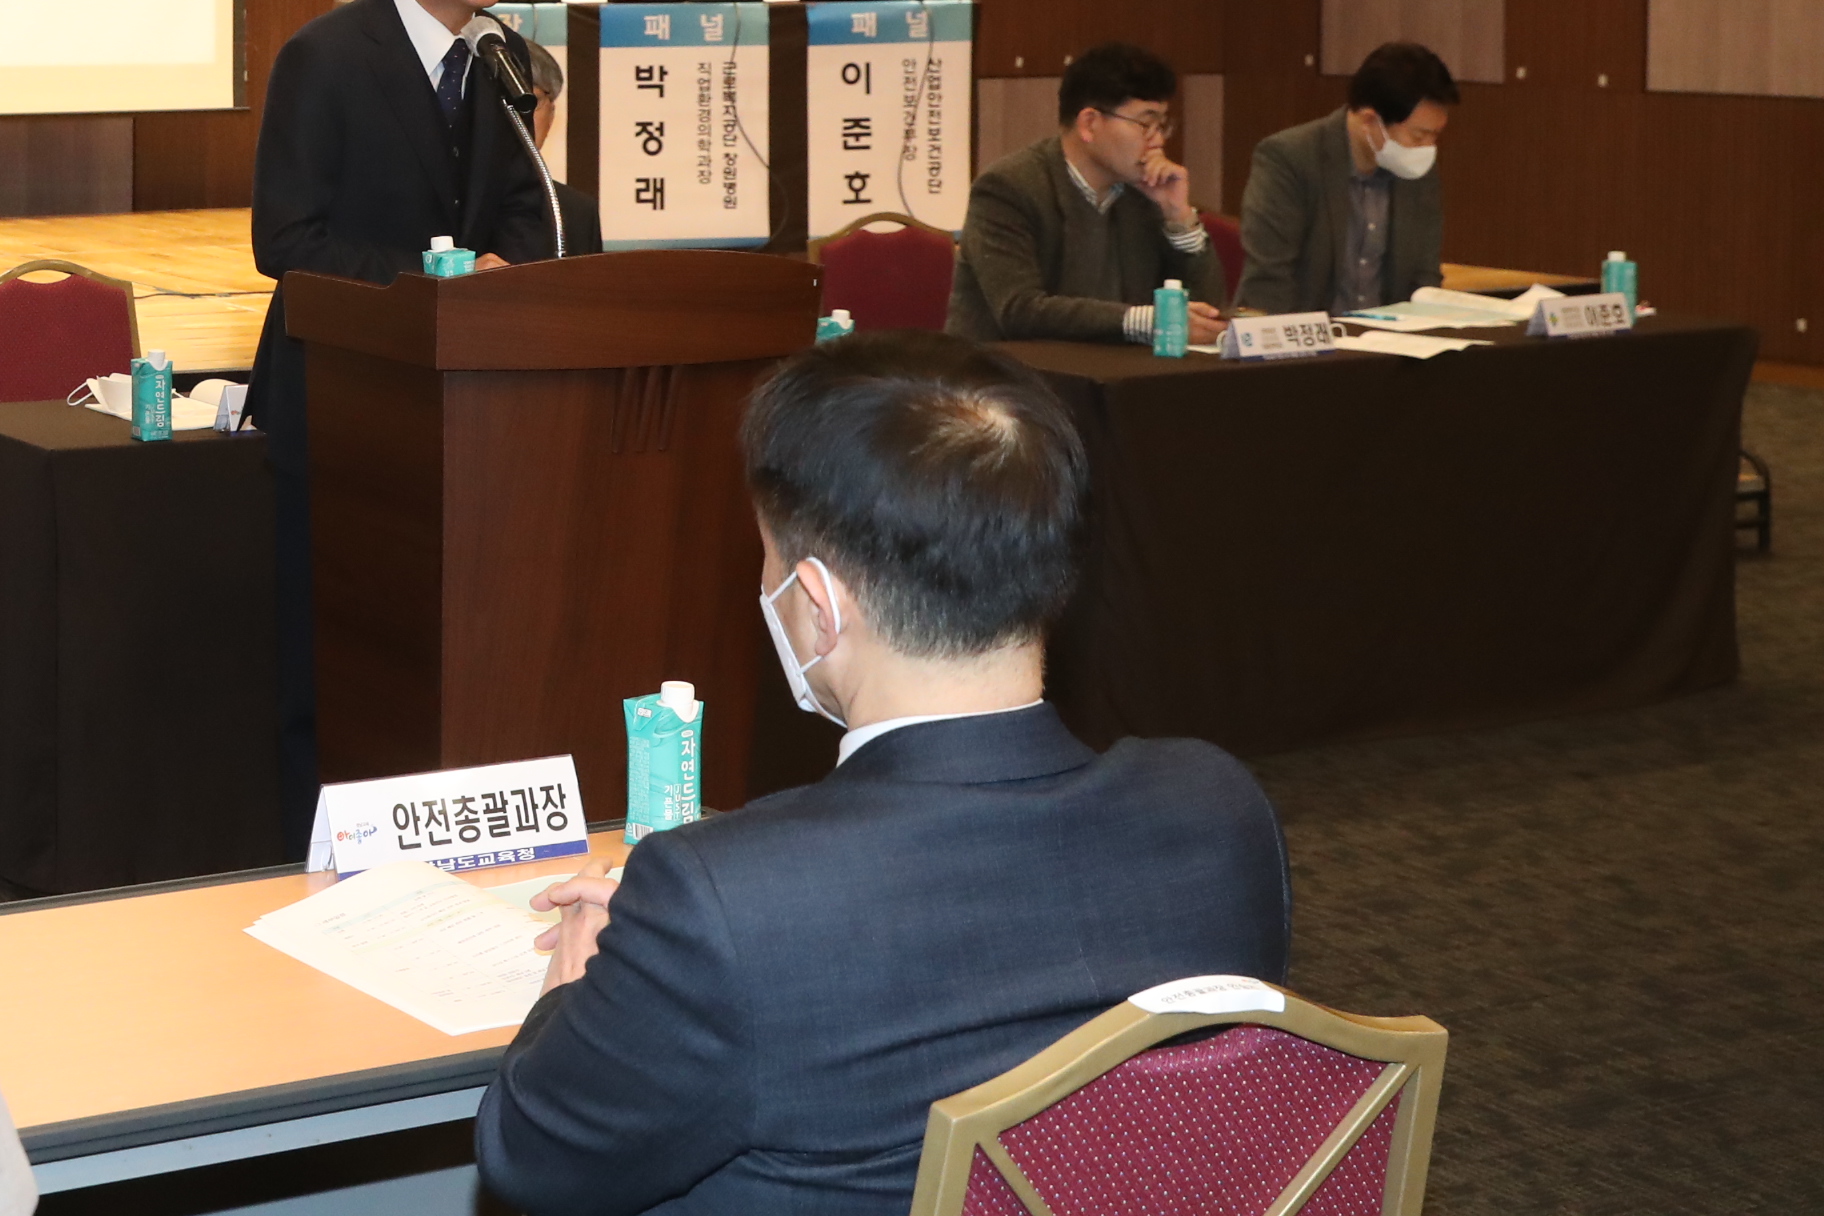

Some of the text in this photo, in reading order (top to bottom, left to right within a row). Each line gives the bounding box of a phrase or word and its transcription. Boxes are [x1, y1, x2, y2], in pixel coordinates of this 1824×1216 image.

[643, 13, 724, 43] 패널
[851, 12, 928, 38] 패널
[634, 64, 668, 211] 박정래
[841, 62, 872, 205] 이준호
[155, 379, 166, 428] 자연드림
[392, 783, 569, 851] 안전총괄과장
[425, 847, 536, 872] 남도교육청
